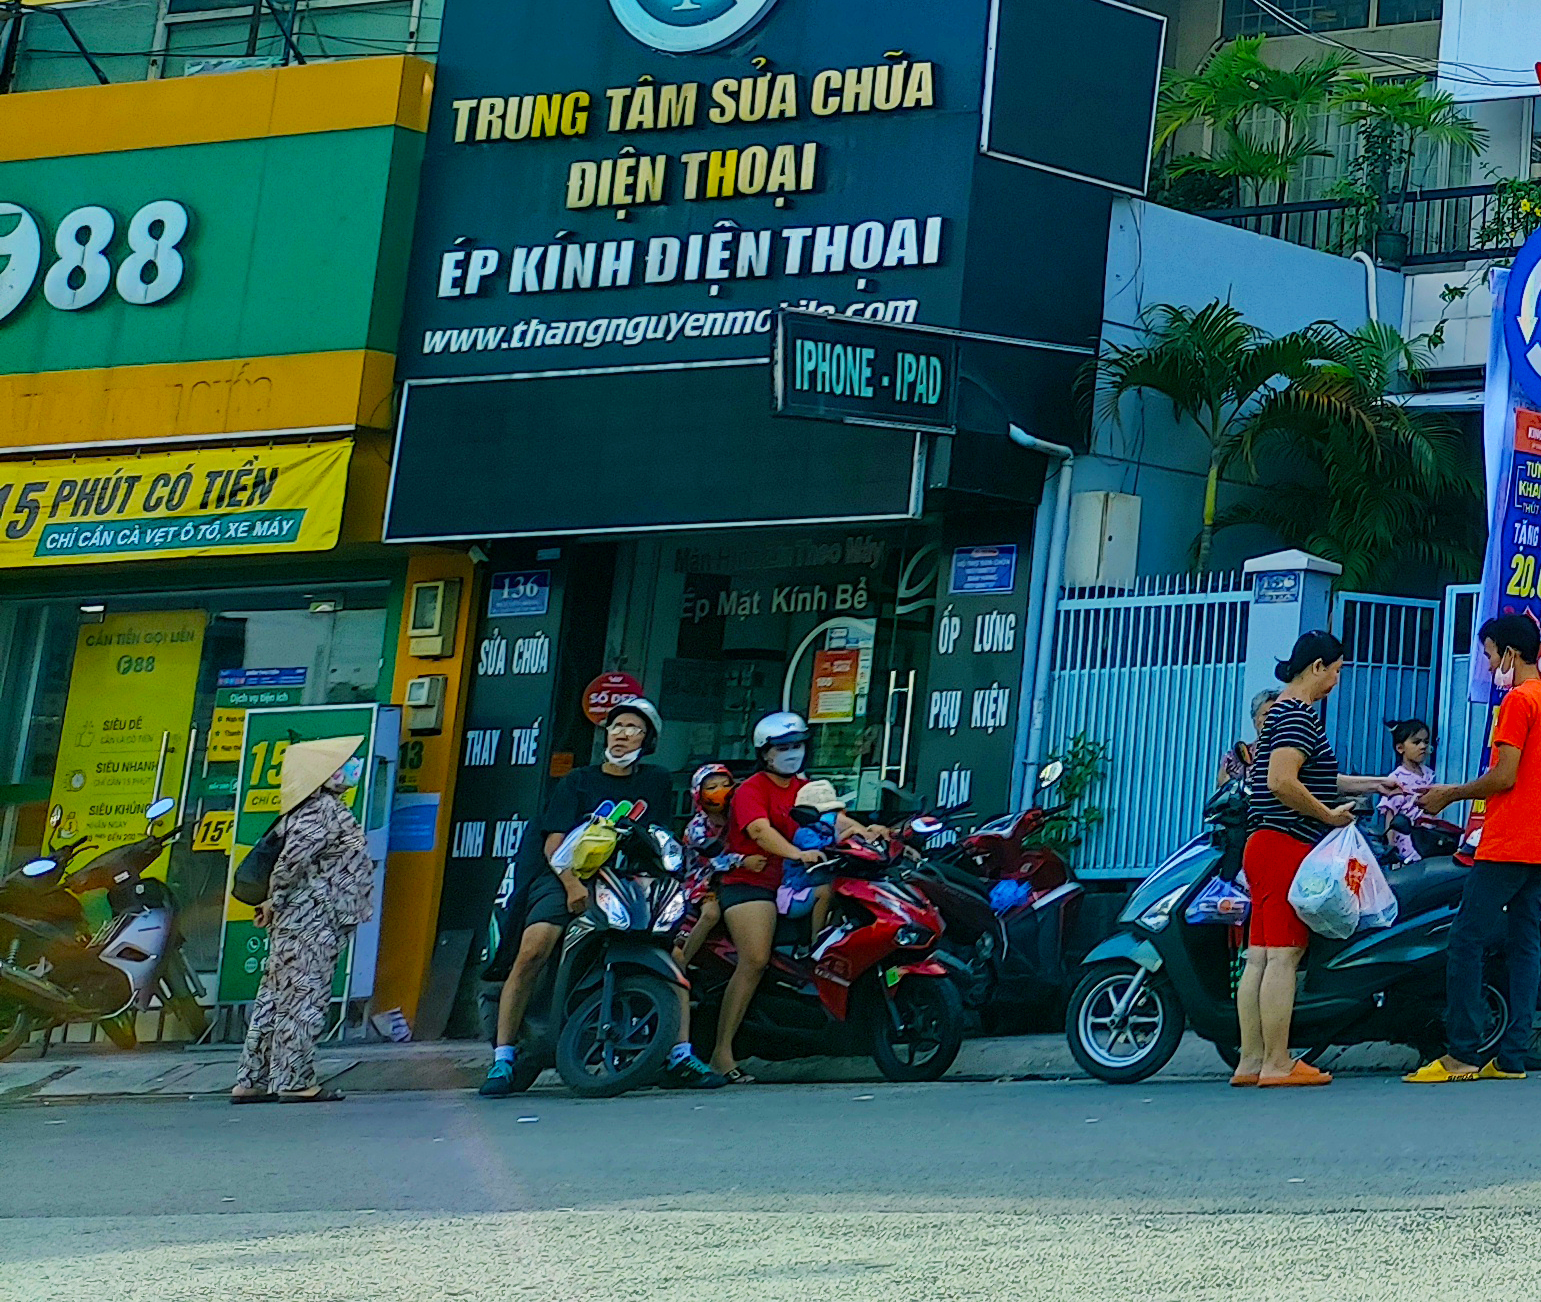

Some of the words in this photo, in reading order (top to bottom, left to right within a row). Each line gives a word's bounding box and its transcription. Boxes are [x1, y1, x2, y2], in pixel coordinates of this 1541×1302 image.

[452, 92, 589, 143] TRUNG
[606, 76, 697, 135] TÂM
[708, 55, 798, 125] SỬA
[811, 50, 934, 116] CHỮA
[565, 146, 665, 220] ĐIỆN
[681, 142, 817, 209] THOẠI
[437, 236, 500, 298] ÉP
[508, 230, 635, 295] KÍNH
[645, 219, 772, 297] ĐIỆN
[781, 216, 943, 291] THOẠI
[795, 338, 875, 398] IPHONE
[895, 351, 942, 405] IPAD
[48, 468, 143, 518] PHÚT
[142, 463, 195, 513] CÓ
[199, 454, 279, 509] TIỀN
[46, 527, 76, 549] CHỈ
[117, 523, 139, 545] CÀ
[145, 526, 173, 548] VẸT
[226, 521, 253, 538] XE
[254, 517, 294, 536] MÁY
[1514, 520, 1538, 551] TẶNG
[502, 575, 540, 598] 136
[771, 585, 827, 614] Kính
[835, 576, 868, 610] Bể
[478, 627, 505, 675] SỬA
[512, 630, 549, 674] CHỮA
[938, 604, 961, 654] ỐP
[973, 610, 1016, 653] LƯNG
[928, 690, 962, 735] PHỤ
[971, 682, 1010, 734] KIỆN
[465, 730, 501, 766] THAY
[511, 716, 542, 765] THẾ
[937, 762, 971, 808] DÁN
[452, 821, 486, 857] LINH
